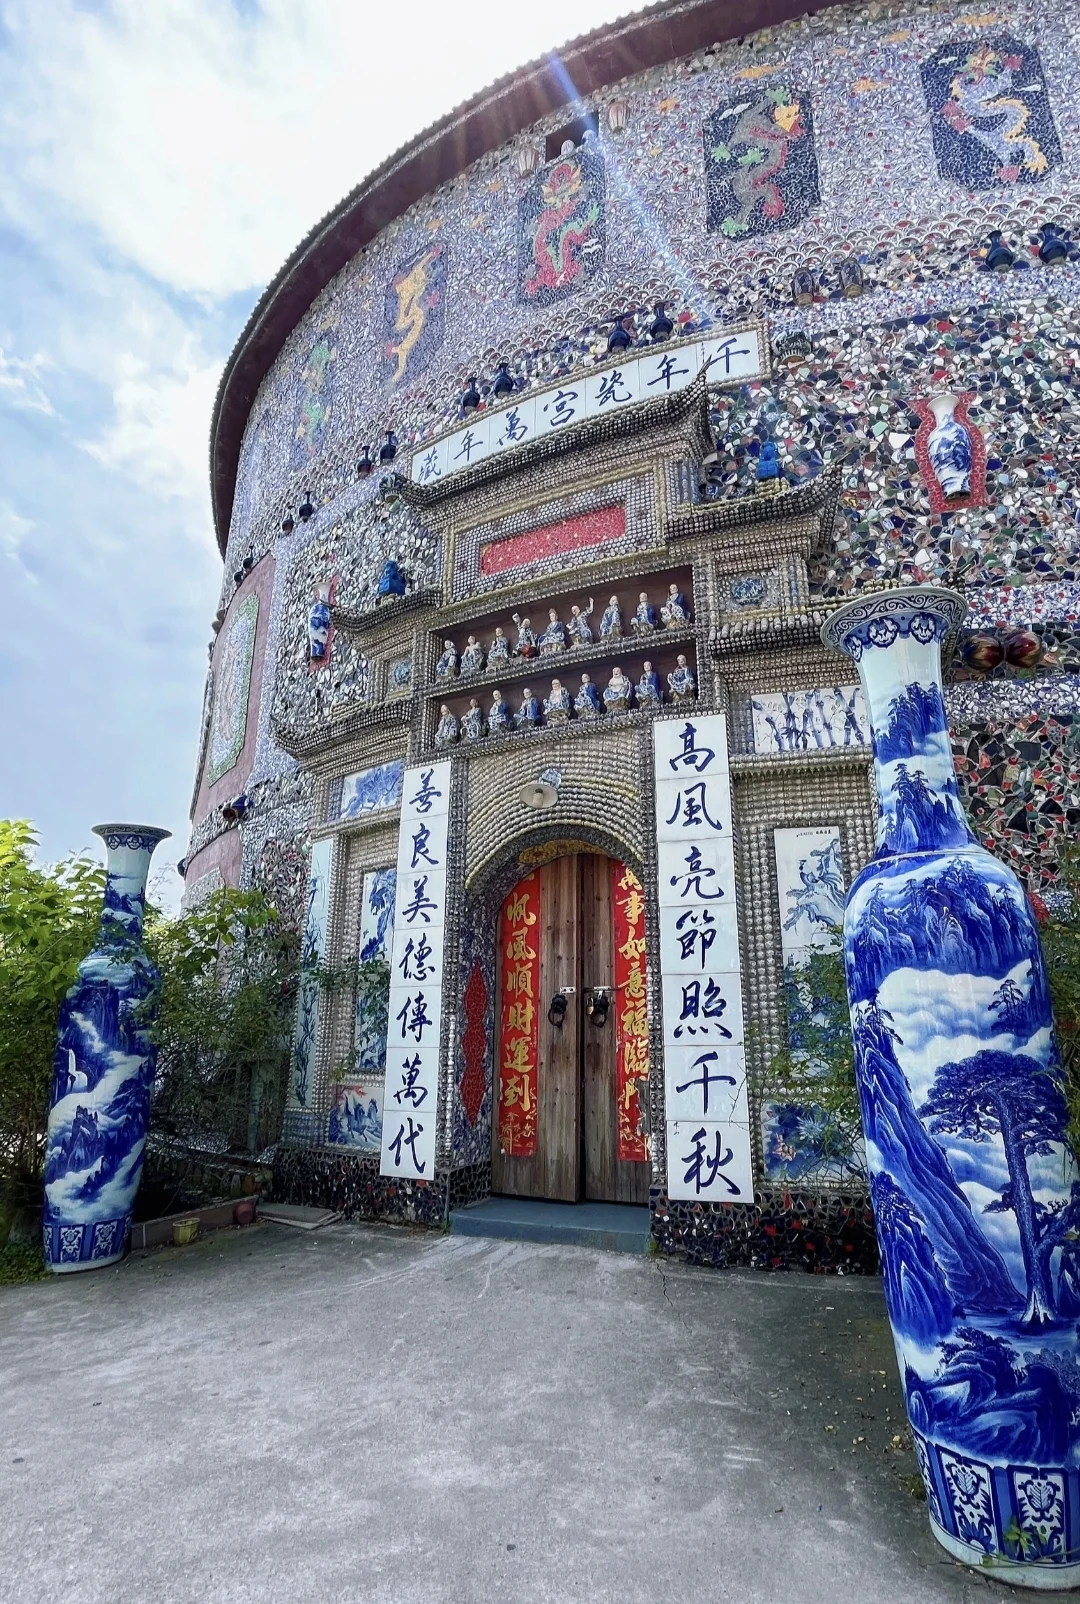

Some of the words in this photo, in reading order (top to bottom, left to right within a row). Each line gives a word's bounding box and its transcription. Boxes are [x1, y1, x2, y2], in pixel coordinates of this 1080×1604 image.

[388, 769, 442, 1174] 善良美德傳萬代
[666, 723, 740, 1193] 高風亮節照千秋
